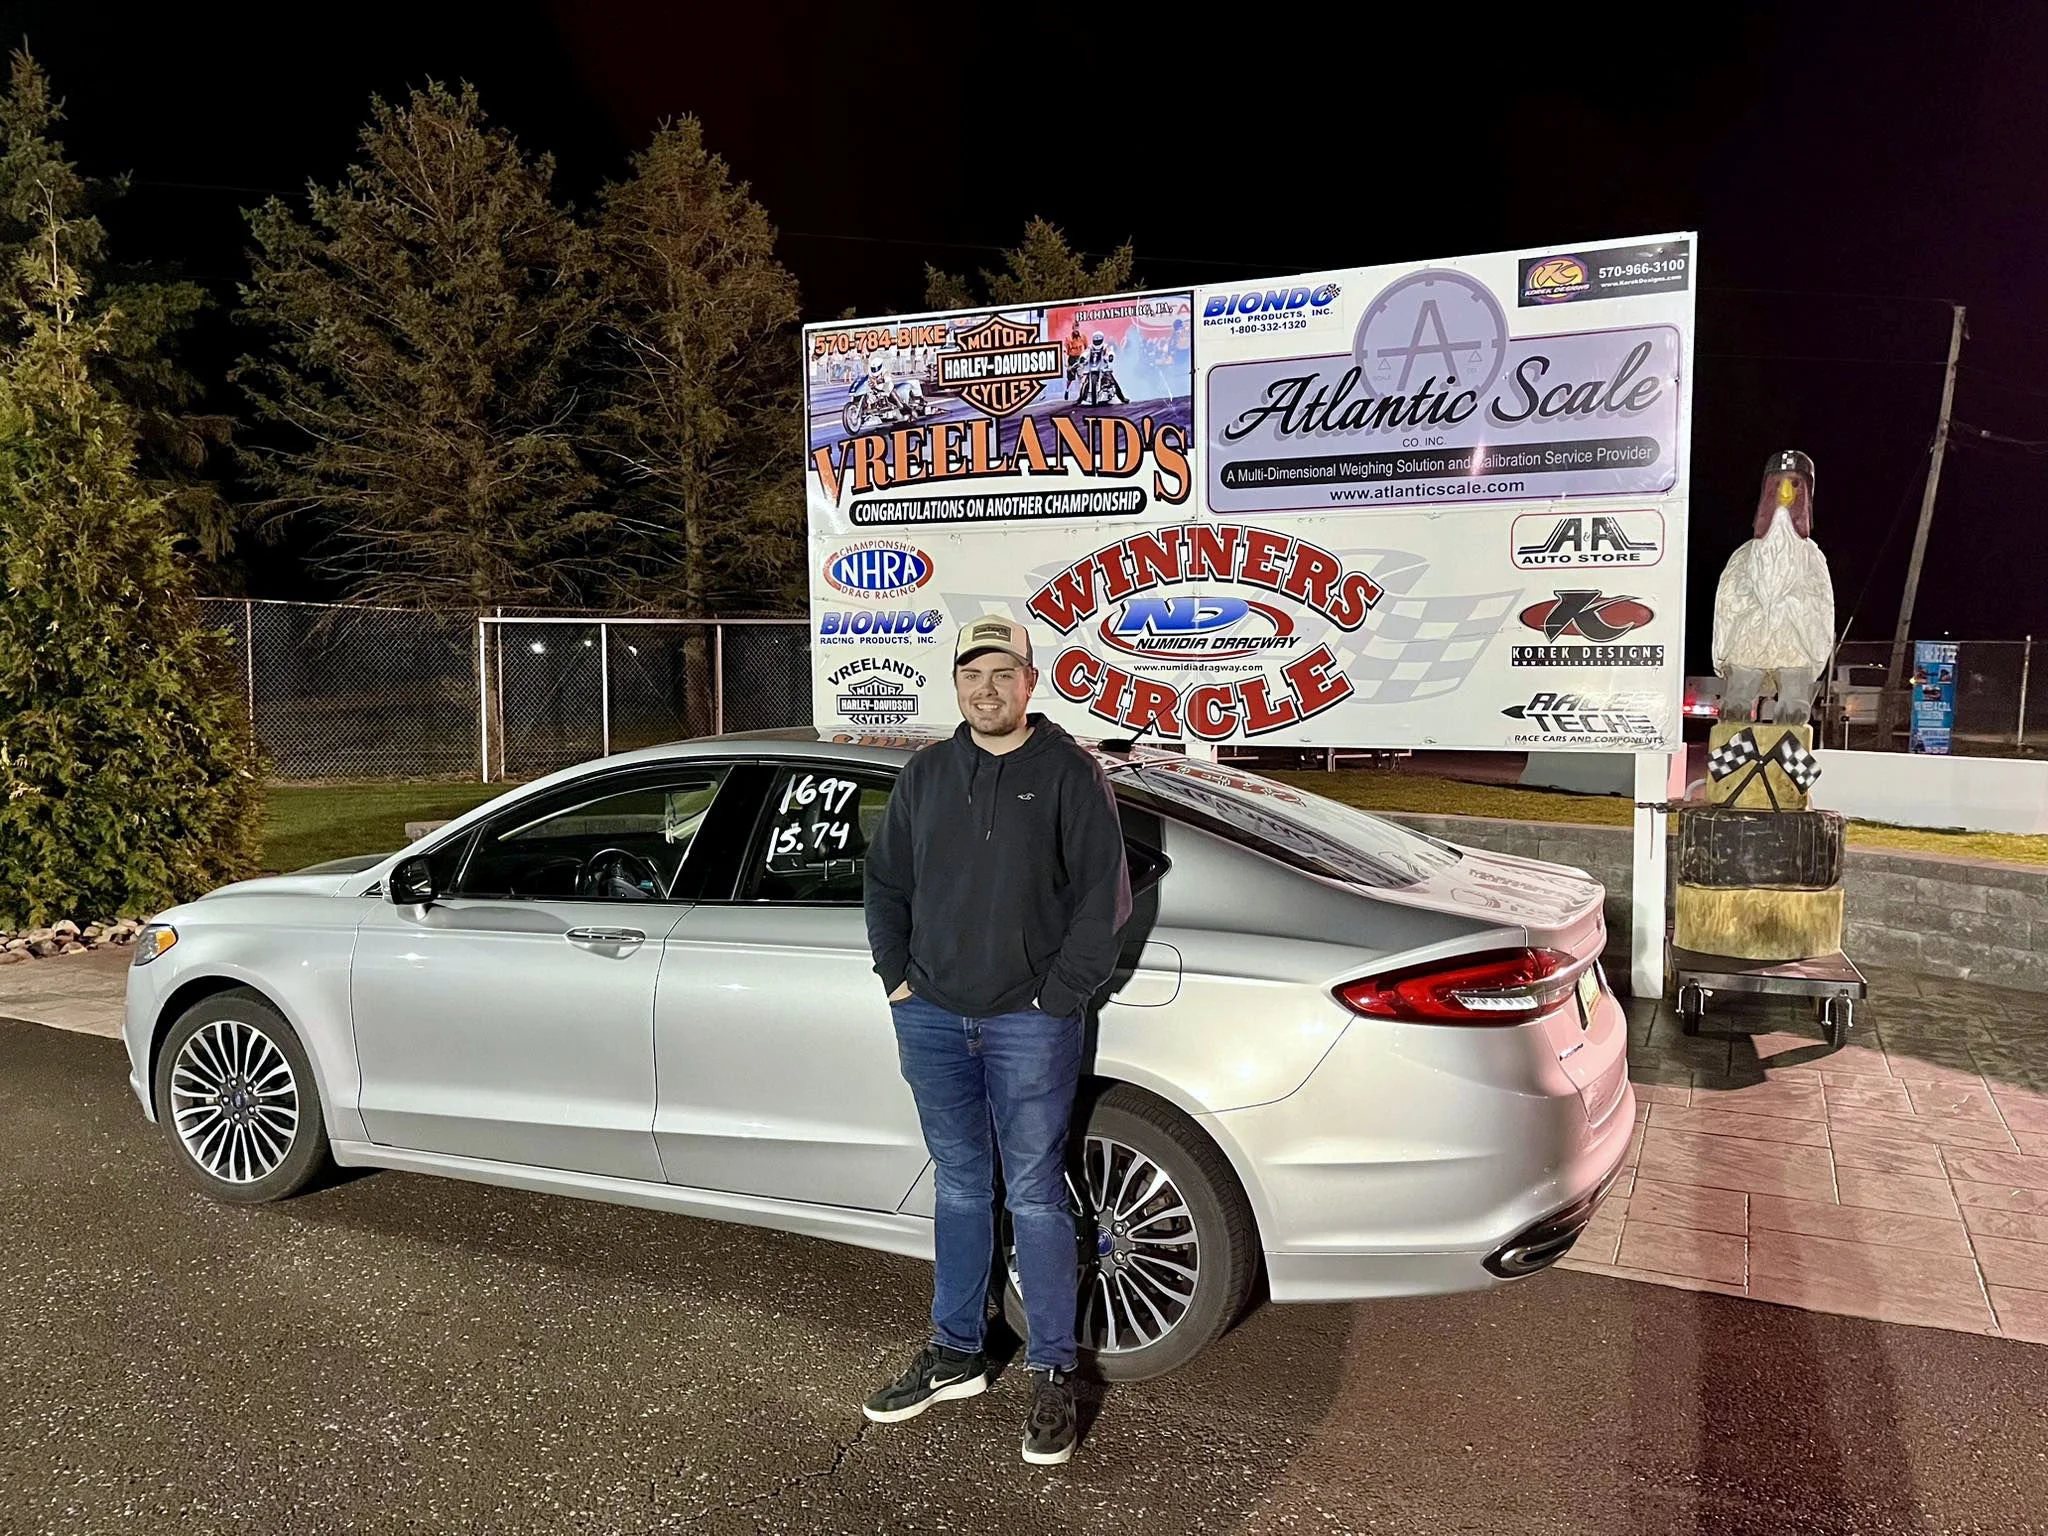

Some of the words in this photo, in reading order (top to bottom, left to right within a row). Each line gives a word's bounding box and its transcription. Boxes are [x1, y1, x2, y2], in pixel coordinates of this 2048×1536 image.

[1599, 259, 1685, 278] 570-966-3100
[1203, 284, 1336, 317] BIONDO
[1203, 317, 1241, 326] RACING
[1248, 311, 1306, 322] PRODUCTS,
[1312, 308, 1333, 316] INC.
[1230, 320, 1307, 334] 1-800-332-1320
[815, 324, 946, 355] 570-784-BIKE
[967, 325, 1027, 350] MOTOR
[944, 353, 1056, 379] HARLEY-DAVIDSON
[971, 381, 1031, 409] CYCLES
[1224, 366, 1479, 441] Atlantic
[1491, 340, 1665, 424] Scale
[1425, 436, 1447, 446] INC.
[811, 414, 1193, 508] VREELAND'S
[1226, 470, 1235, 482] A
[1238, 464, 1336, 482] Multi-Dimensional
[1340, 462, 1393, 478] Weighing
[1396, 458, 1444, 473] Solution
[1450, 458, 1471, 471] and
[1473, 454, 1541, 469] alibration
[1545, 450, 1593, 465] Service
[1597, 446, 1652, 462] Provider
[1330, 479, 1525, 500] www.atlanticscale.com
[855, 498, 964, 522] CONGRATULATIONS
[967, 498, 984, 517] ON
[986, 494, 1043, 516] ANOTHER
[1044, 490, 1141, 514] CHAMPIONSHIP
[839, 540, 916, 556] CHAMPIONSHIP
[1522, 555, 1572, 564] AUTO
[1578, 553, 1640, 562] STORE
[841, 551, 918, 588] NHRA
[1026, 523, 1384, 636] WINNERS
[841, 586, 870, 599] DRAG
[875, 585, 916, 599] RACING
[820, 611, 938, 634] BIONDO
[1112, 597, 1249, 636] ND
[820, 637, 854, 645] RACING
[860, 636, 912, 645] PRODUCTS,
[918, 636, 937, 644] INC.
[1135, 638, 1205, 650] NUMIDIA
[1211, 637, 1301, 649] DRAGWAY
[1512, 647, 1569, 659] KOREK
[1583, 646, 1663, 658] DESIGNS
[828, 658, 927, 687] VREELAND'S
[1134, 664, 1263, 673] www.numidiadragway.com
[855, 685, 896, 695] MOTOR
[1052, 643, 1354, 740] CIRCLE
[841, 699, 914, 710] HARLEY-DAVIDSON
[859, 714, 897, 724] CYCLES
[779, 774, 857, 815] 1697
